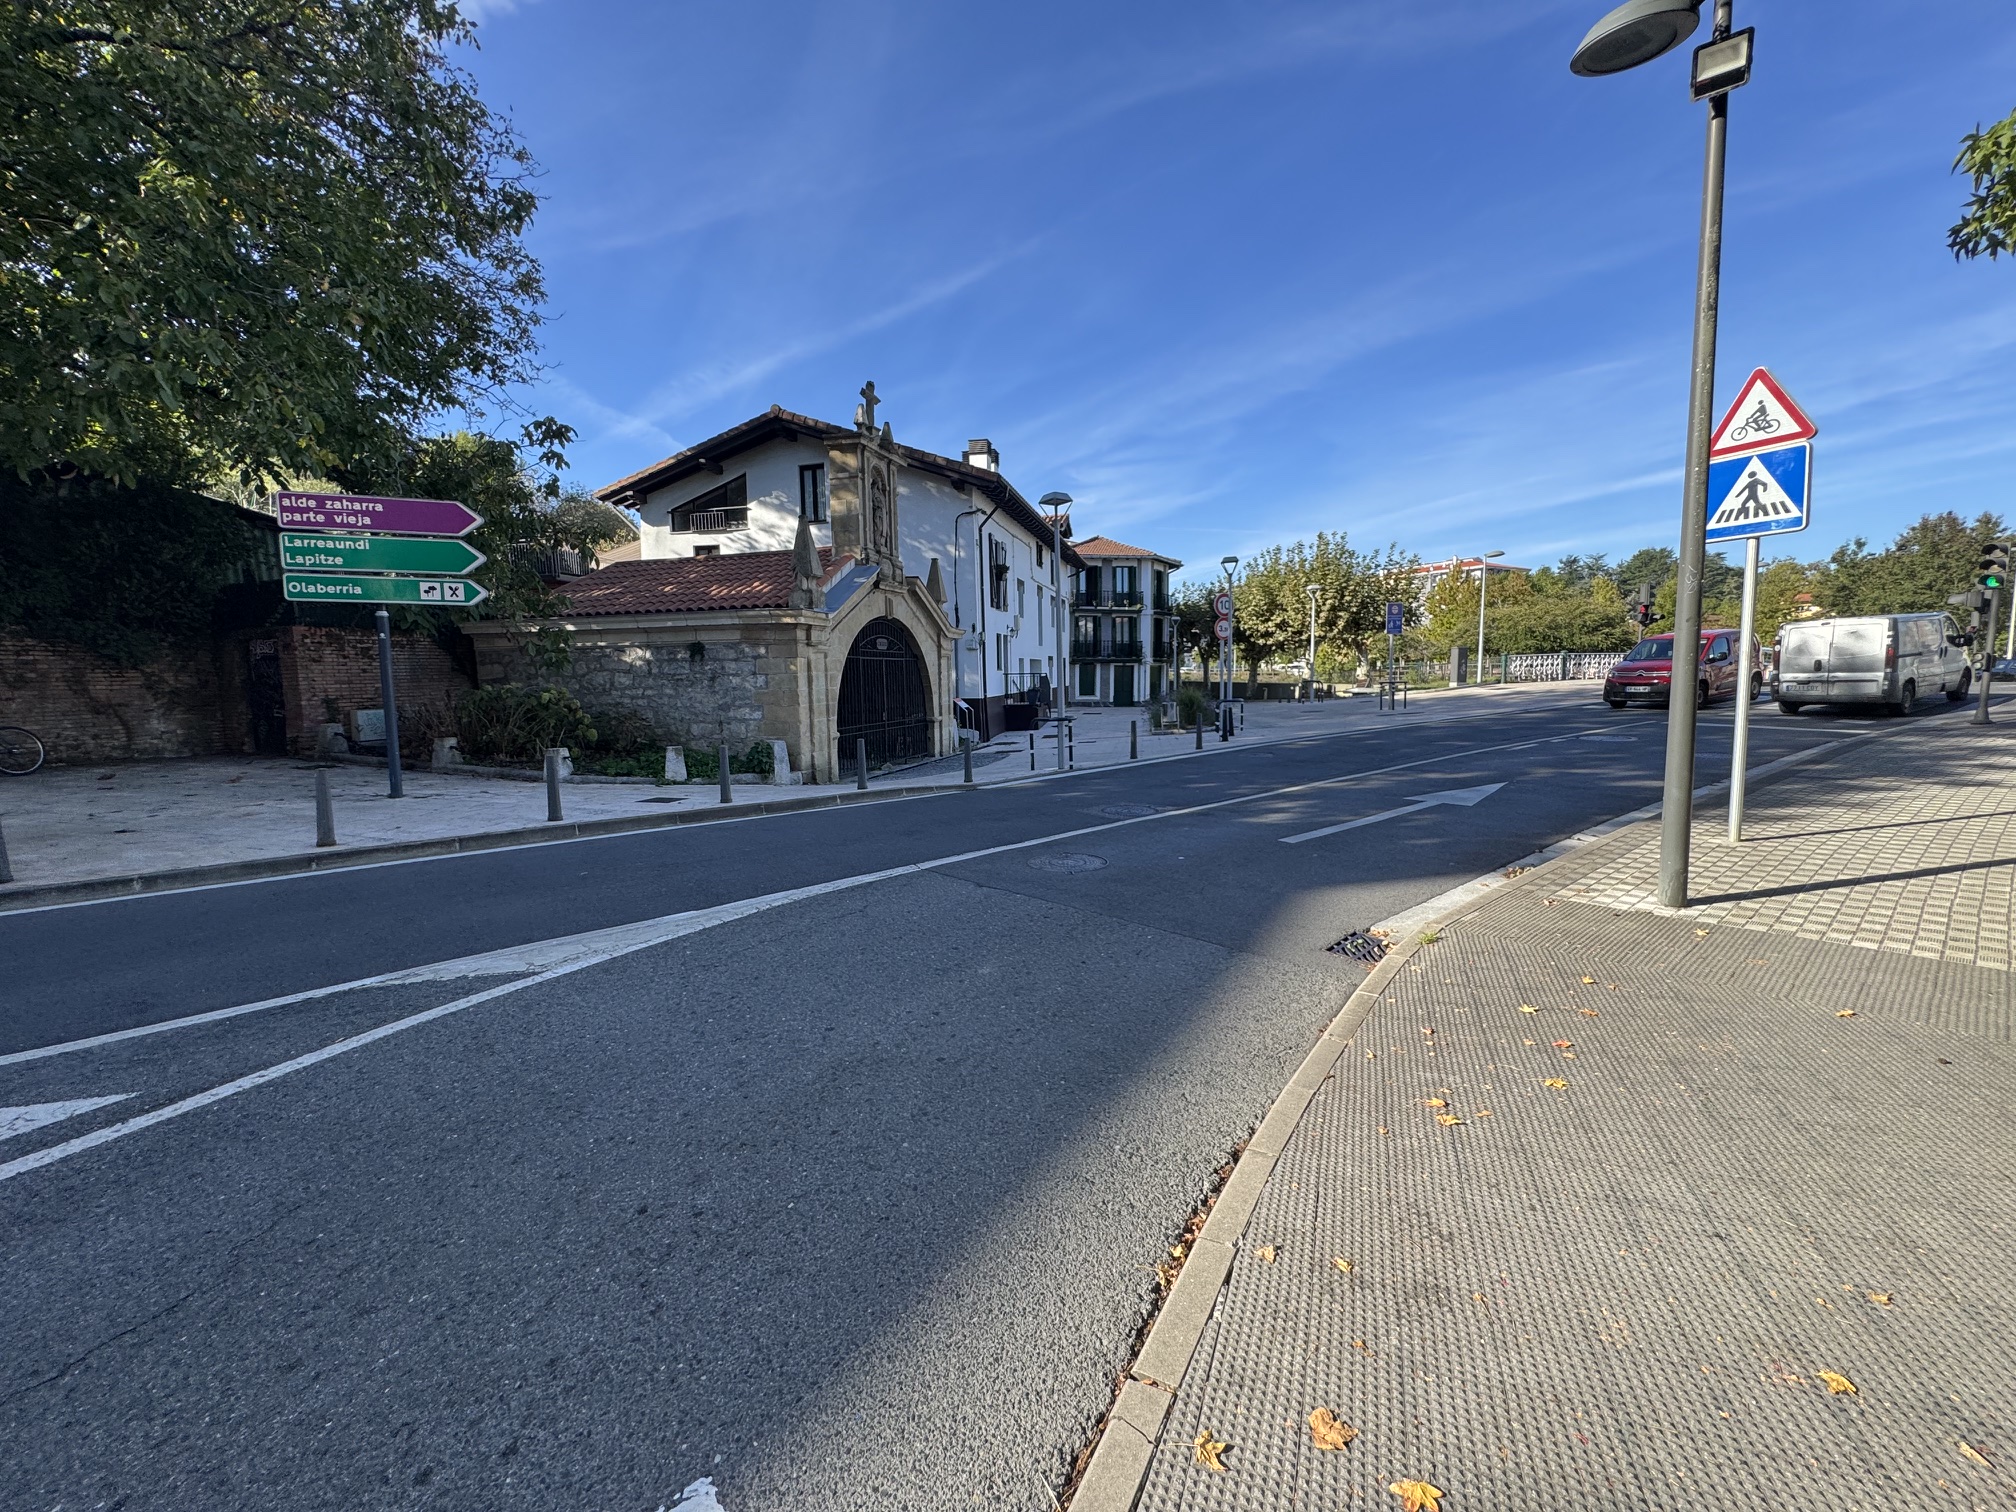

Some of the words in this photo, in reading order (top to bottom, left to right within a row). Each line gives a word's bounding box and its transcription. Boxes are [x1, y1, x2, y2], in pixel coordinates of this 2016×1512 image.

[281, 496, 317, 508] alde
[325, 498, 384, 512] zaharra
[282, 511, 326, 523] parte
[333, 513, 371, 526] vieja
[284, 535, 370, 550] Larreaundi
[285, 552, 344, 566] Lapitze
[288, 581, 363, 595] Olaberria
